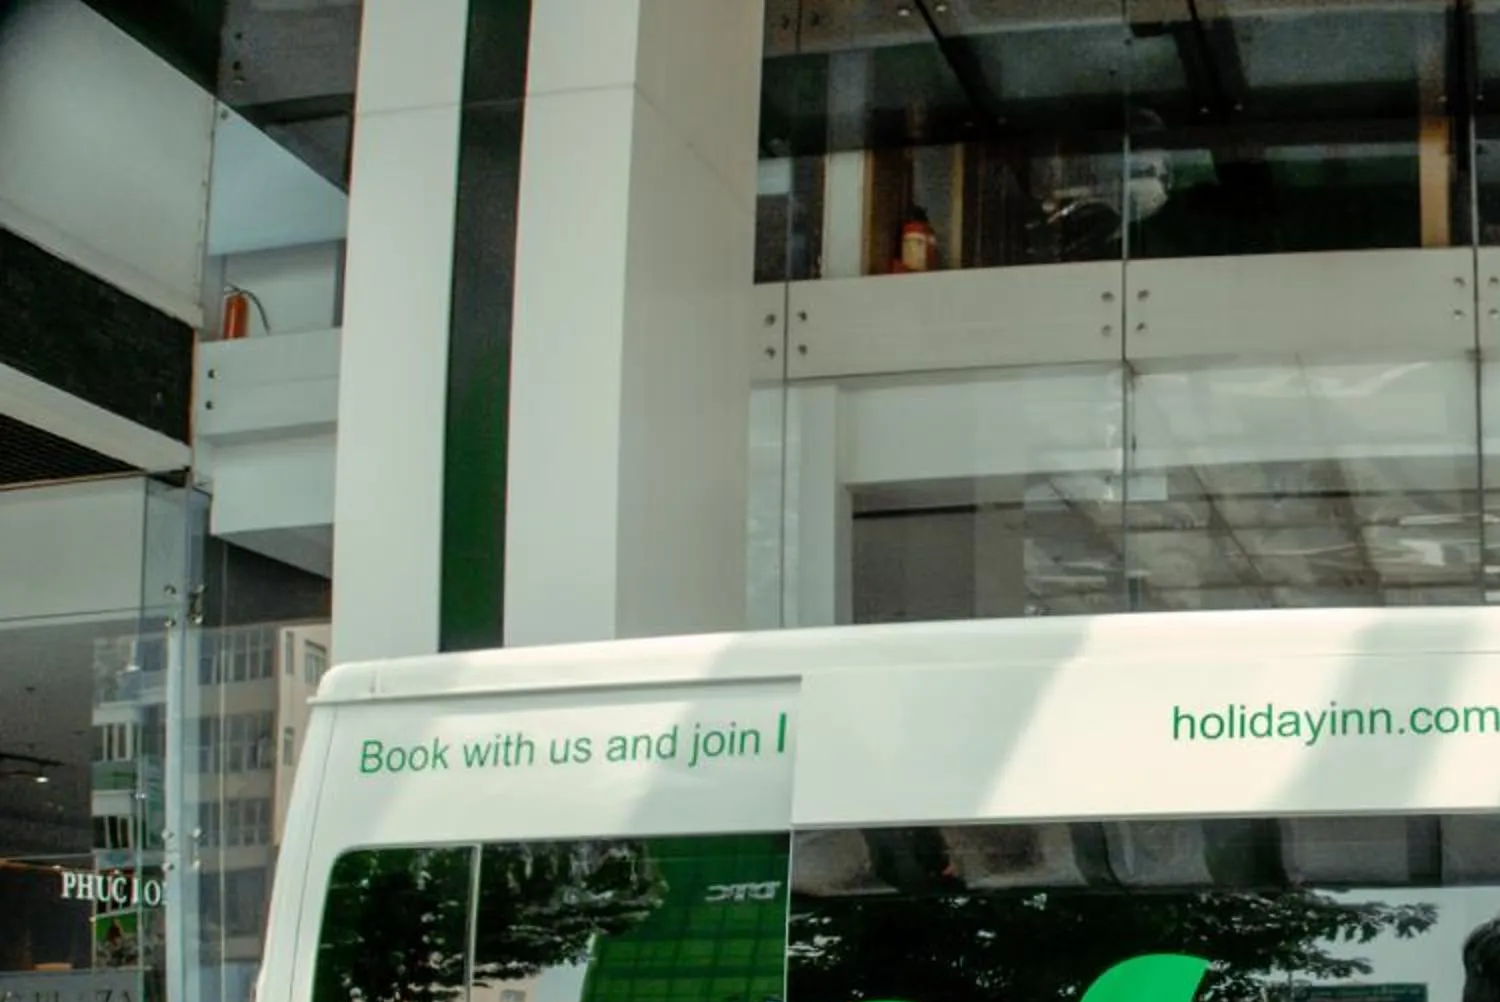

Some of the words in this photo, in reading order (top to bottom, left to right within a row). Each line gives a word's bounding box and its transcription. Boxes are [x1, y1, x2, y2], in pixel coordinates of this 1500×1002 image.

[359, 737, 450, 774] Book
[462, 732, 535, 767] with
[549, 735, 592, 764] us
[606, 724, 679, 762] and
[688, 720, 760, 767] join
[1172, 701, 1500, 746] holidayinn.com
